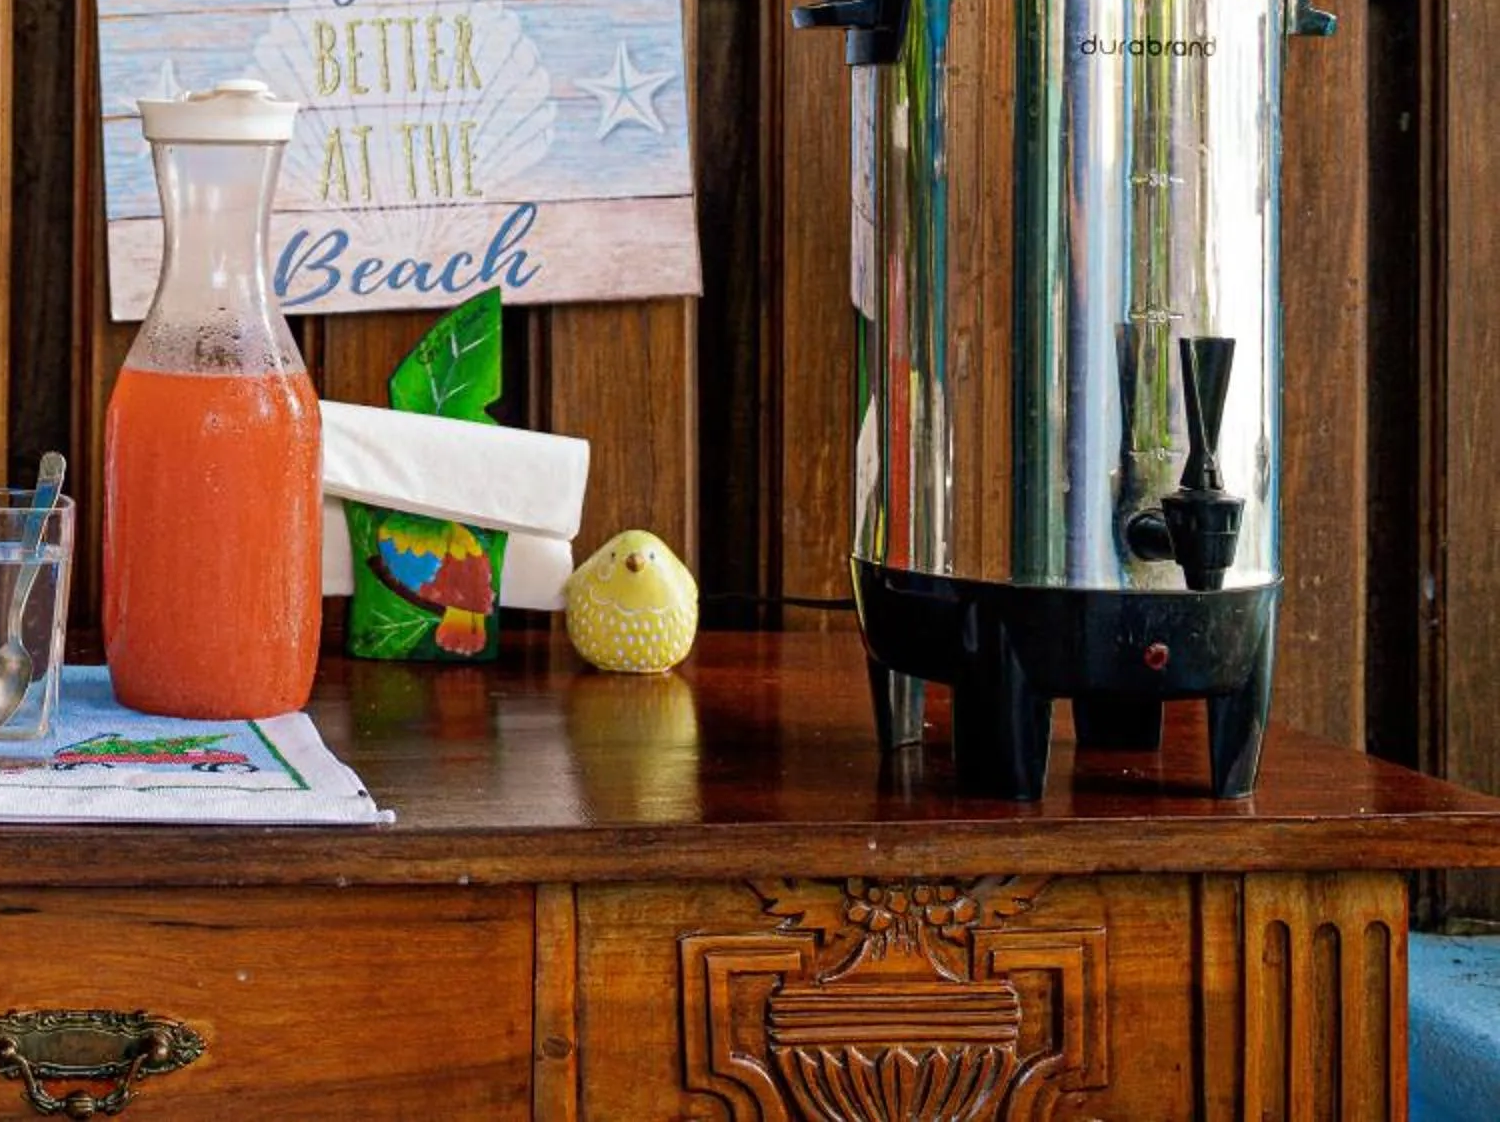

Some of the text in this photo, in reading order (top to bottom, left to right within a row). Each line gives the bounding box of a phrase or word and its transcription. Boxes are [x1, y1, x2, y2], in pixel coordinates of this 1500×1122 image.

[313, 15, 482, 97] BETTER
[1080, 33, 1217, 57] durabrand
[320, 120, 484, 203] AT THE
[272, 202, 541, 307] Beach
